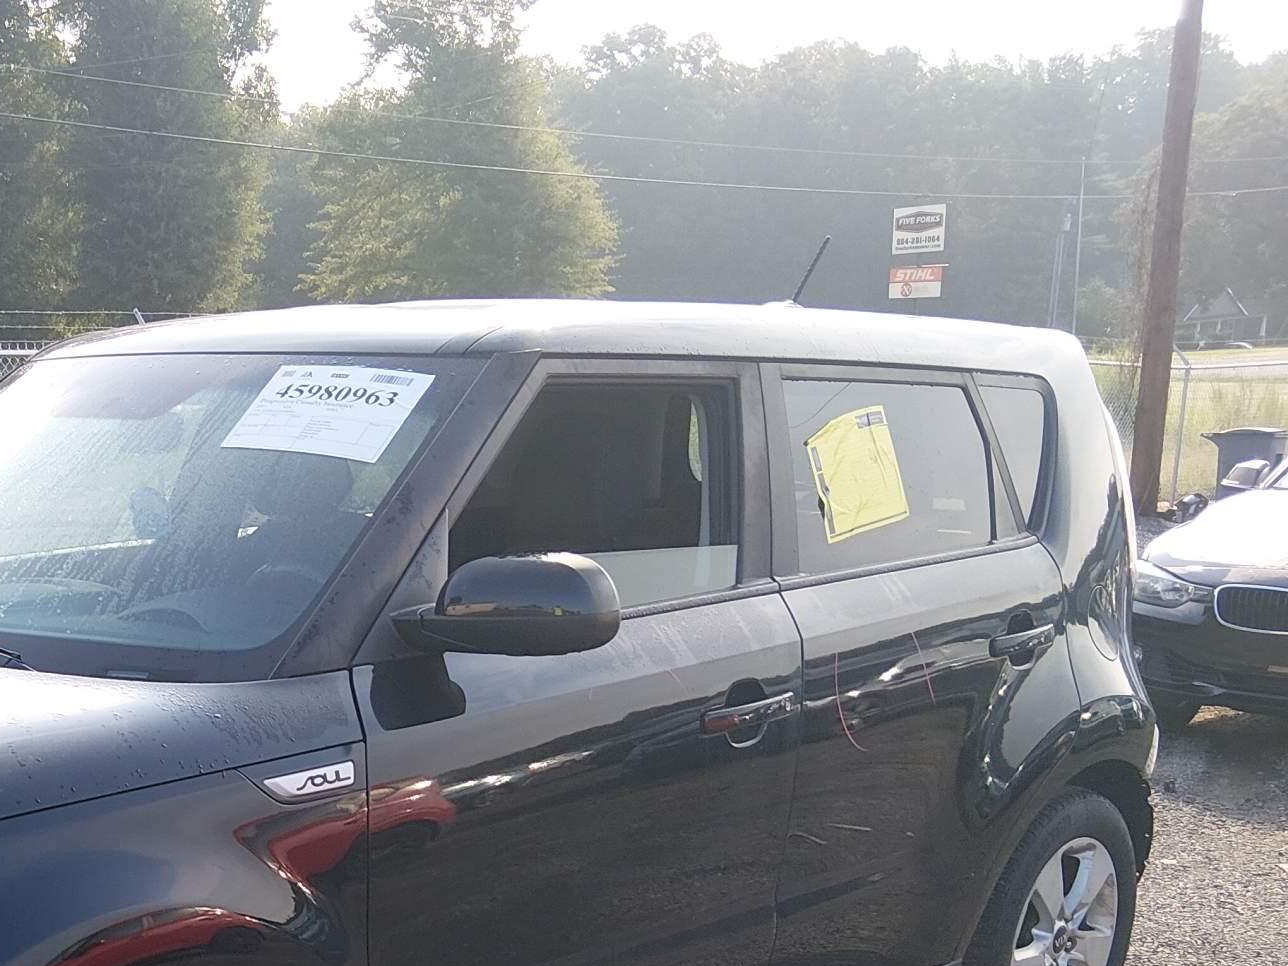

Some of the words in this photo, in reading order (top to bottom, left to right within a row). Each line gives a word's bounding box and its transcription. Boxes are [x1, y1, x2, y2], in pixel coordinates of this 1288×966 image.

[898, 217, 916, 226] FIVE
[916, 215, 941, 224] FORKS
[895, 268, 936, 281] STIHL
[275, 383, 400, 408] 45980963
[295, 769, 351, 792] SOUL
